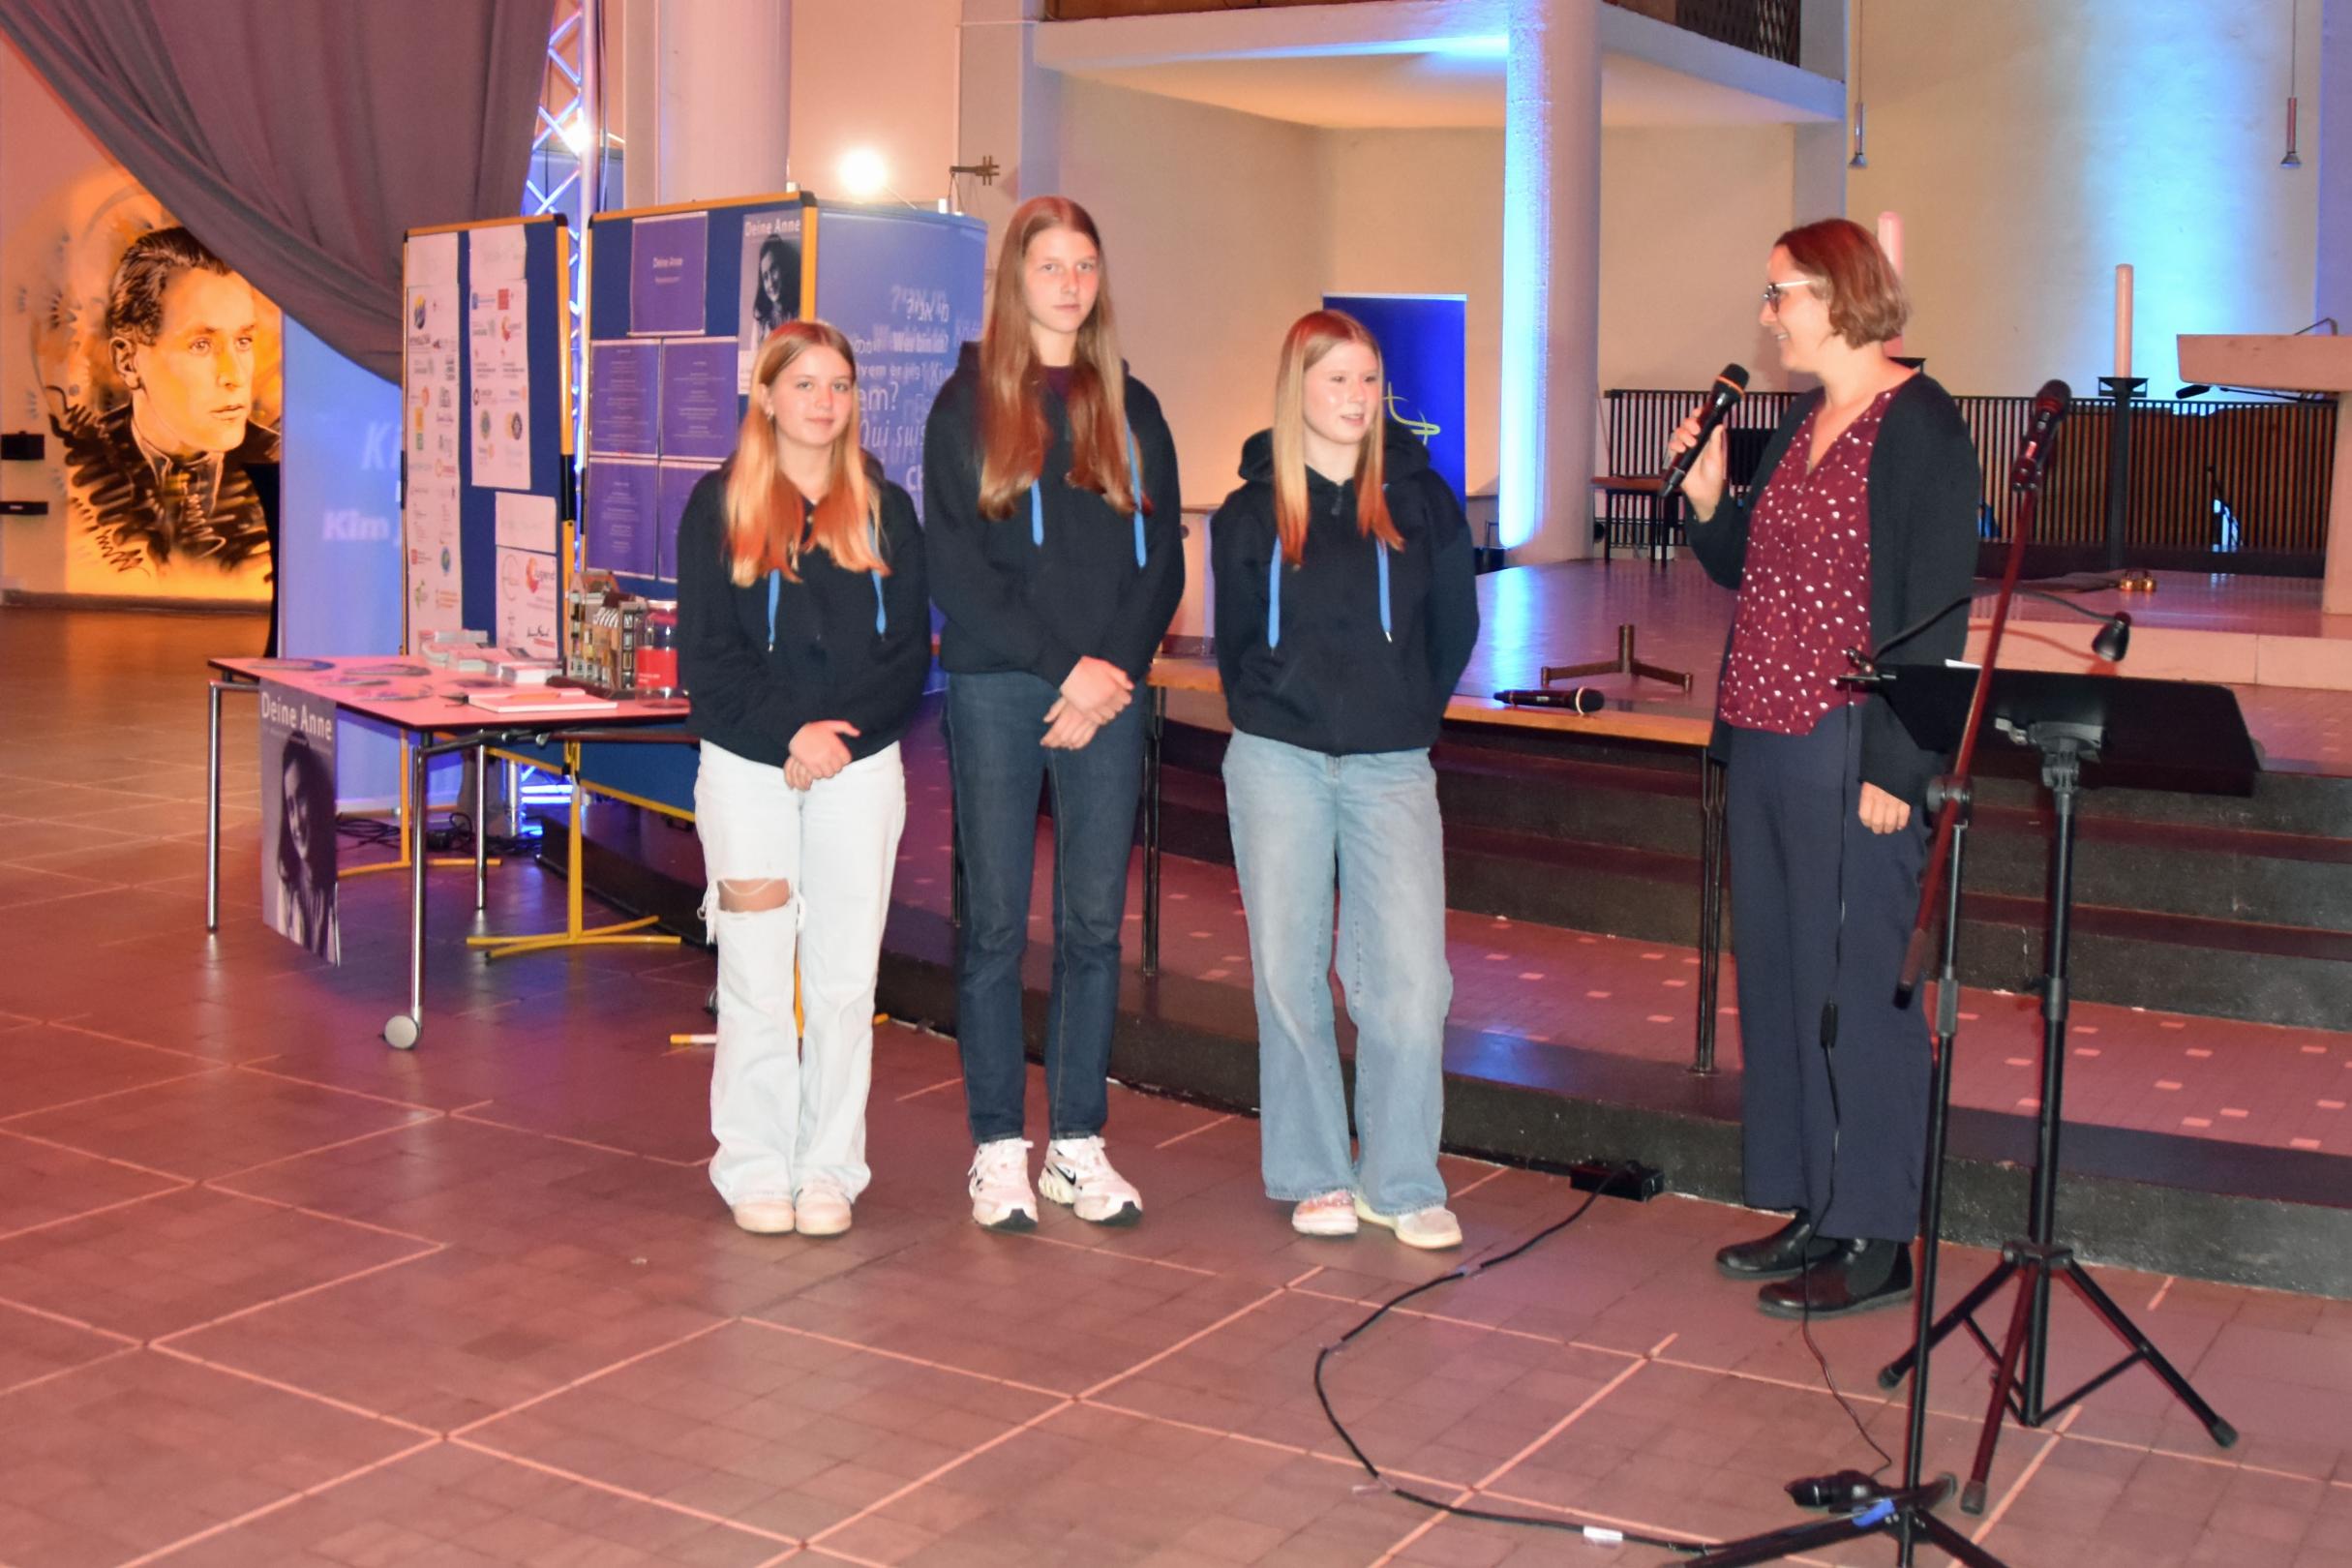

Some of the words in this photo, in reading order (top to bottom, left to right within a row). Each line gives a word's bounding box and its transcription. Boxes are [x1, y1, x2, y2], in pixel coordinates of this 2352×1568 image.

[744, 221, 771, 237] Deine
[774, 218, 800, 233] Anne
[859, 381, 898, 411] em?
[260, 691, 297, 729] Deine
[300, 703, 333, 741] Anne
